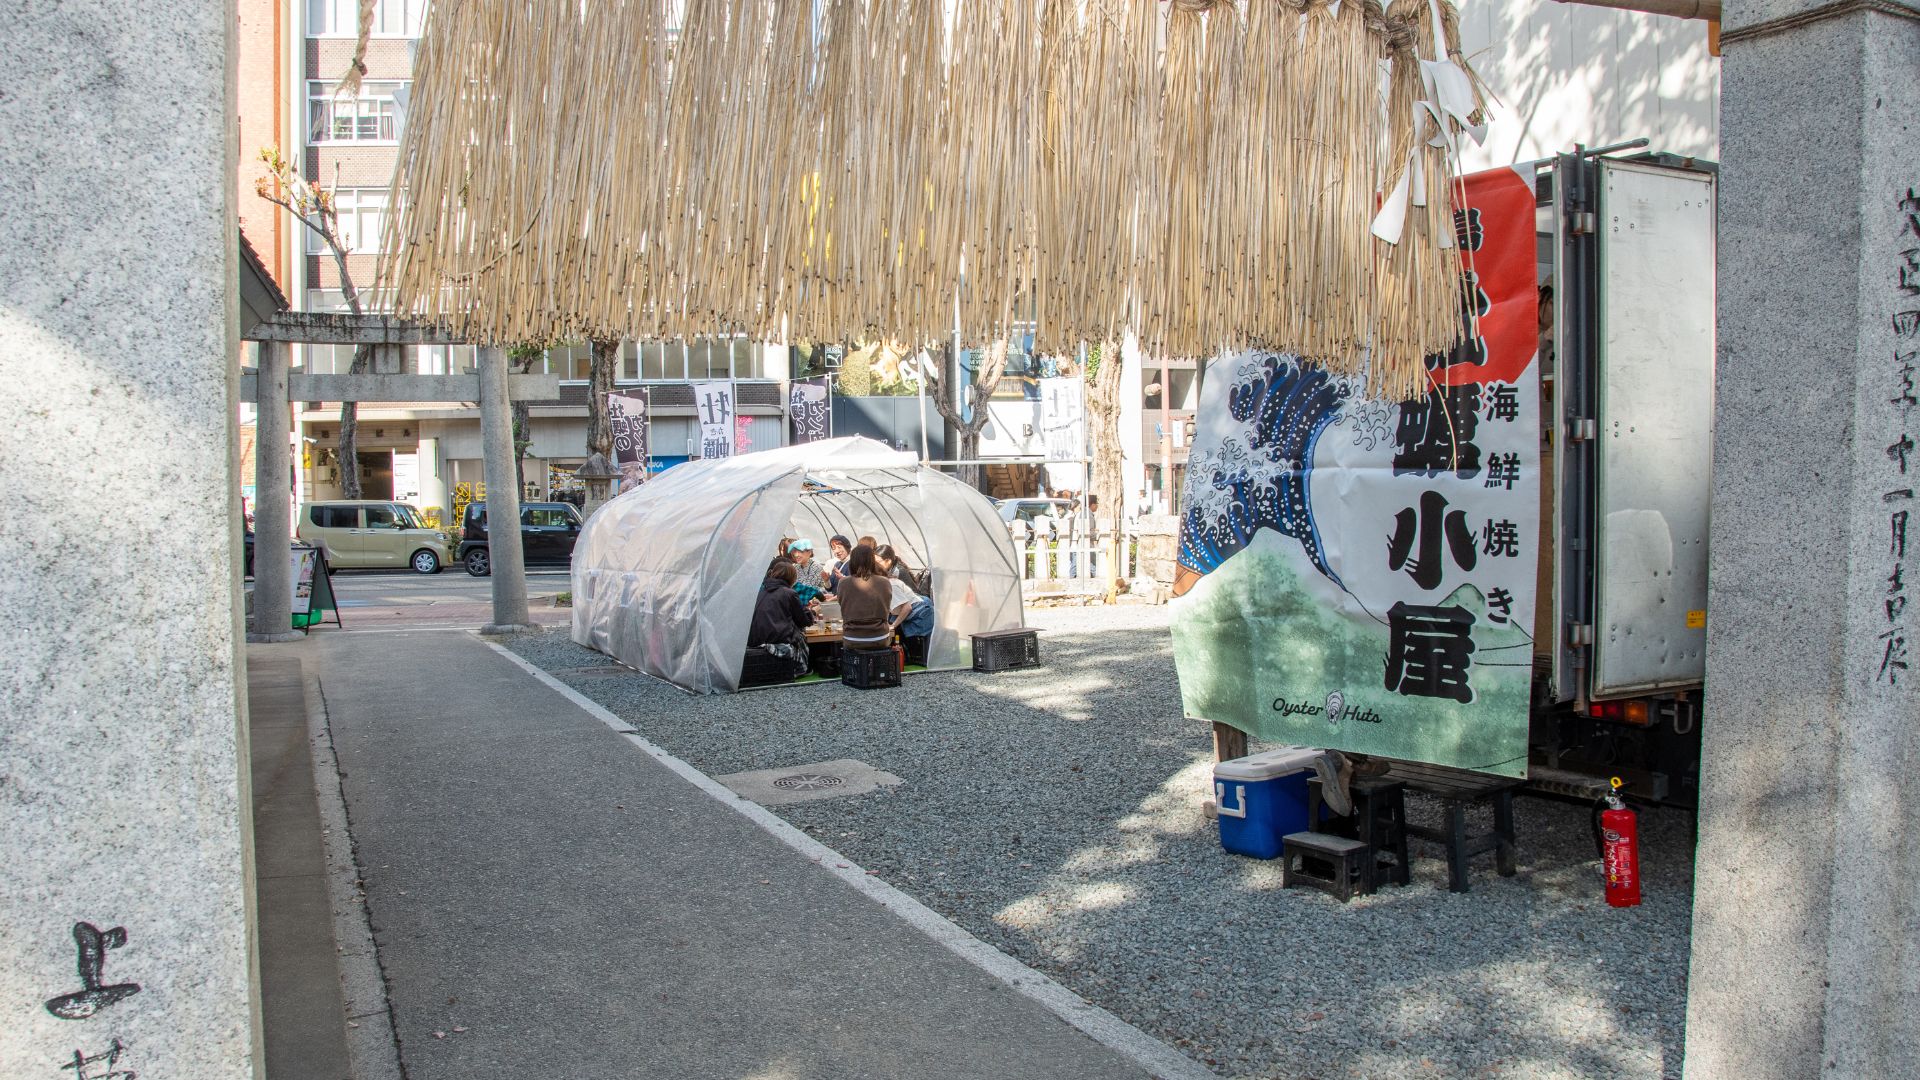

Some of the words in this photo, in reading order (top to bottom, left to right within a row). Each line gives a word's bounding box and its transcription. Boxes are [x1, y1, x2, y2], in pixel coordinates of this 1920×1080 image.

[1482, 385, 1521, 624] 海鮮焼き
[1272, 698, 1324, 717] Oyster
[1342, 705, 1382, 724] Huts
